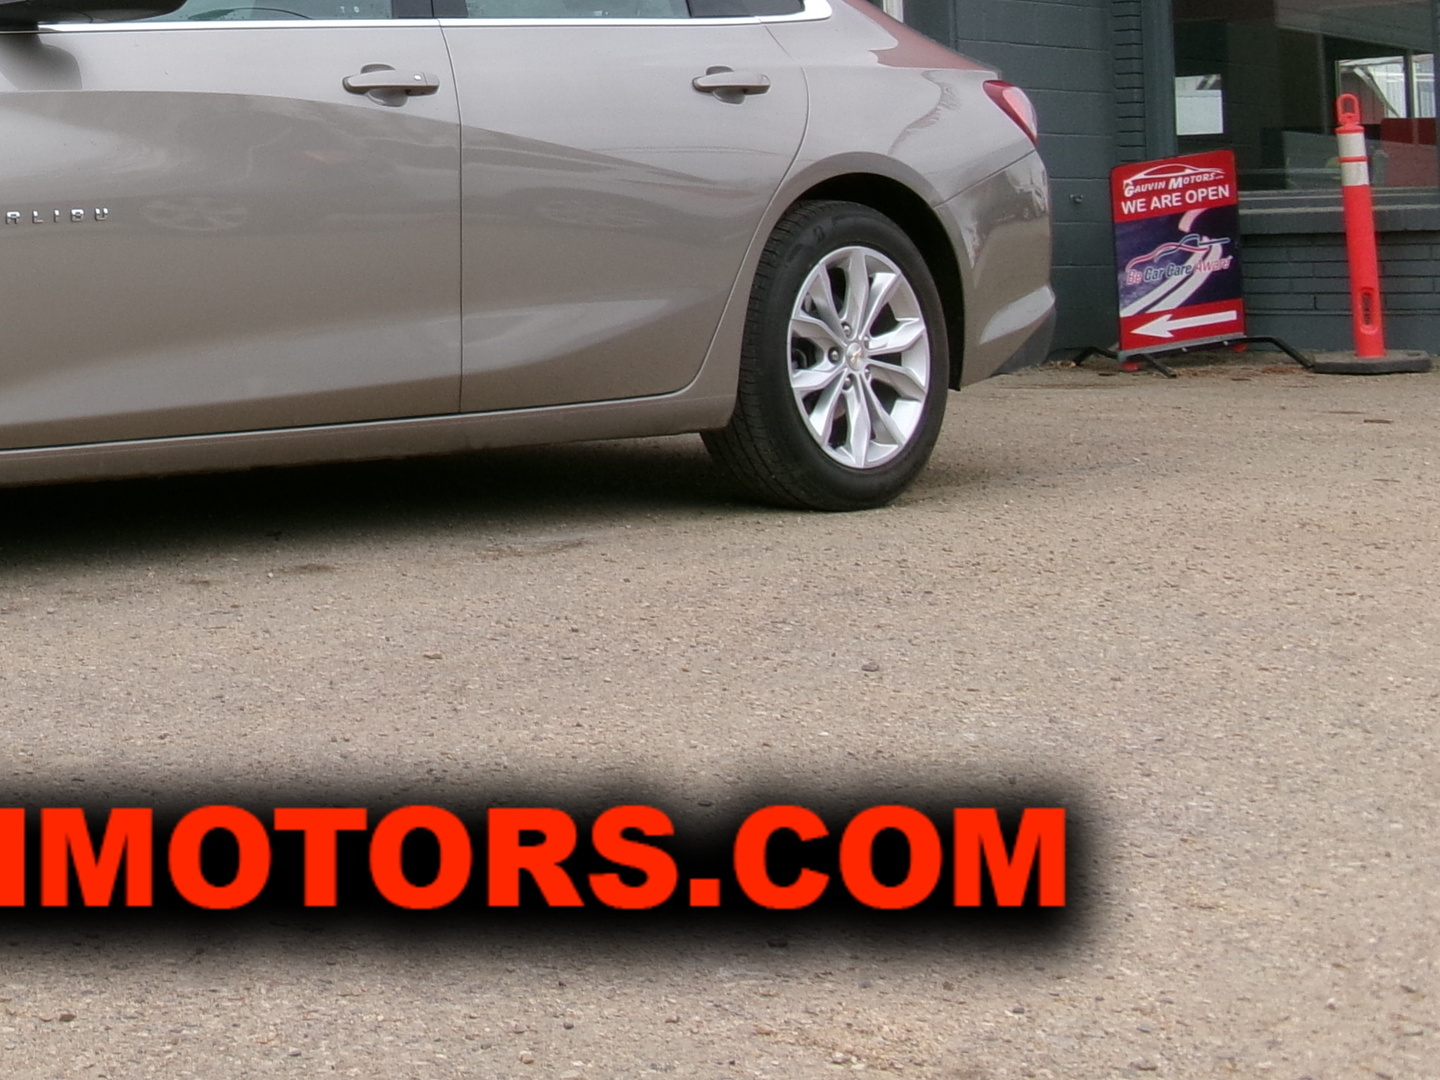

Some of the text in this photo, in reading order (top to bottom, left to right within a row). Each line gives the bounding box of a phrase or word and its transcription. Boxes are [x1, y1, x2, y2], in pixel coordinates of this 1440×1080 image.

[1124, 181, 1165, 197] GAUVIN
[1168, 173, 1215, 190] MOTORS
[1121, 184, 1230, 214] WE ARE OPEN
[1126, 269, 1142, 285] Be
[1144, 267, 1165, 282] Car
[1165, 262, 1193, 278] Care
